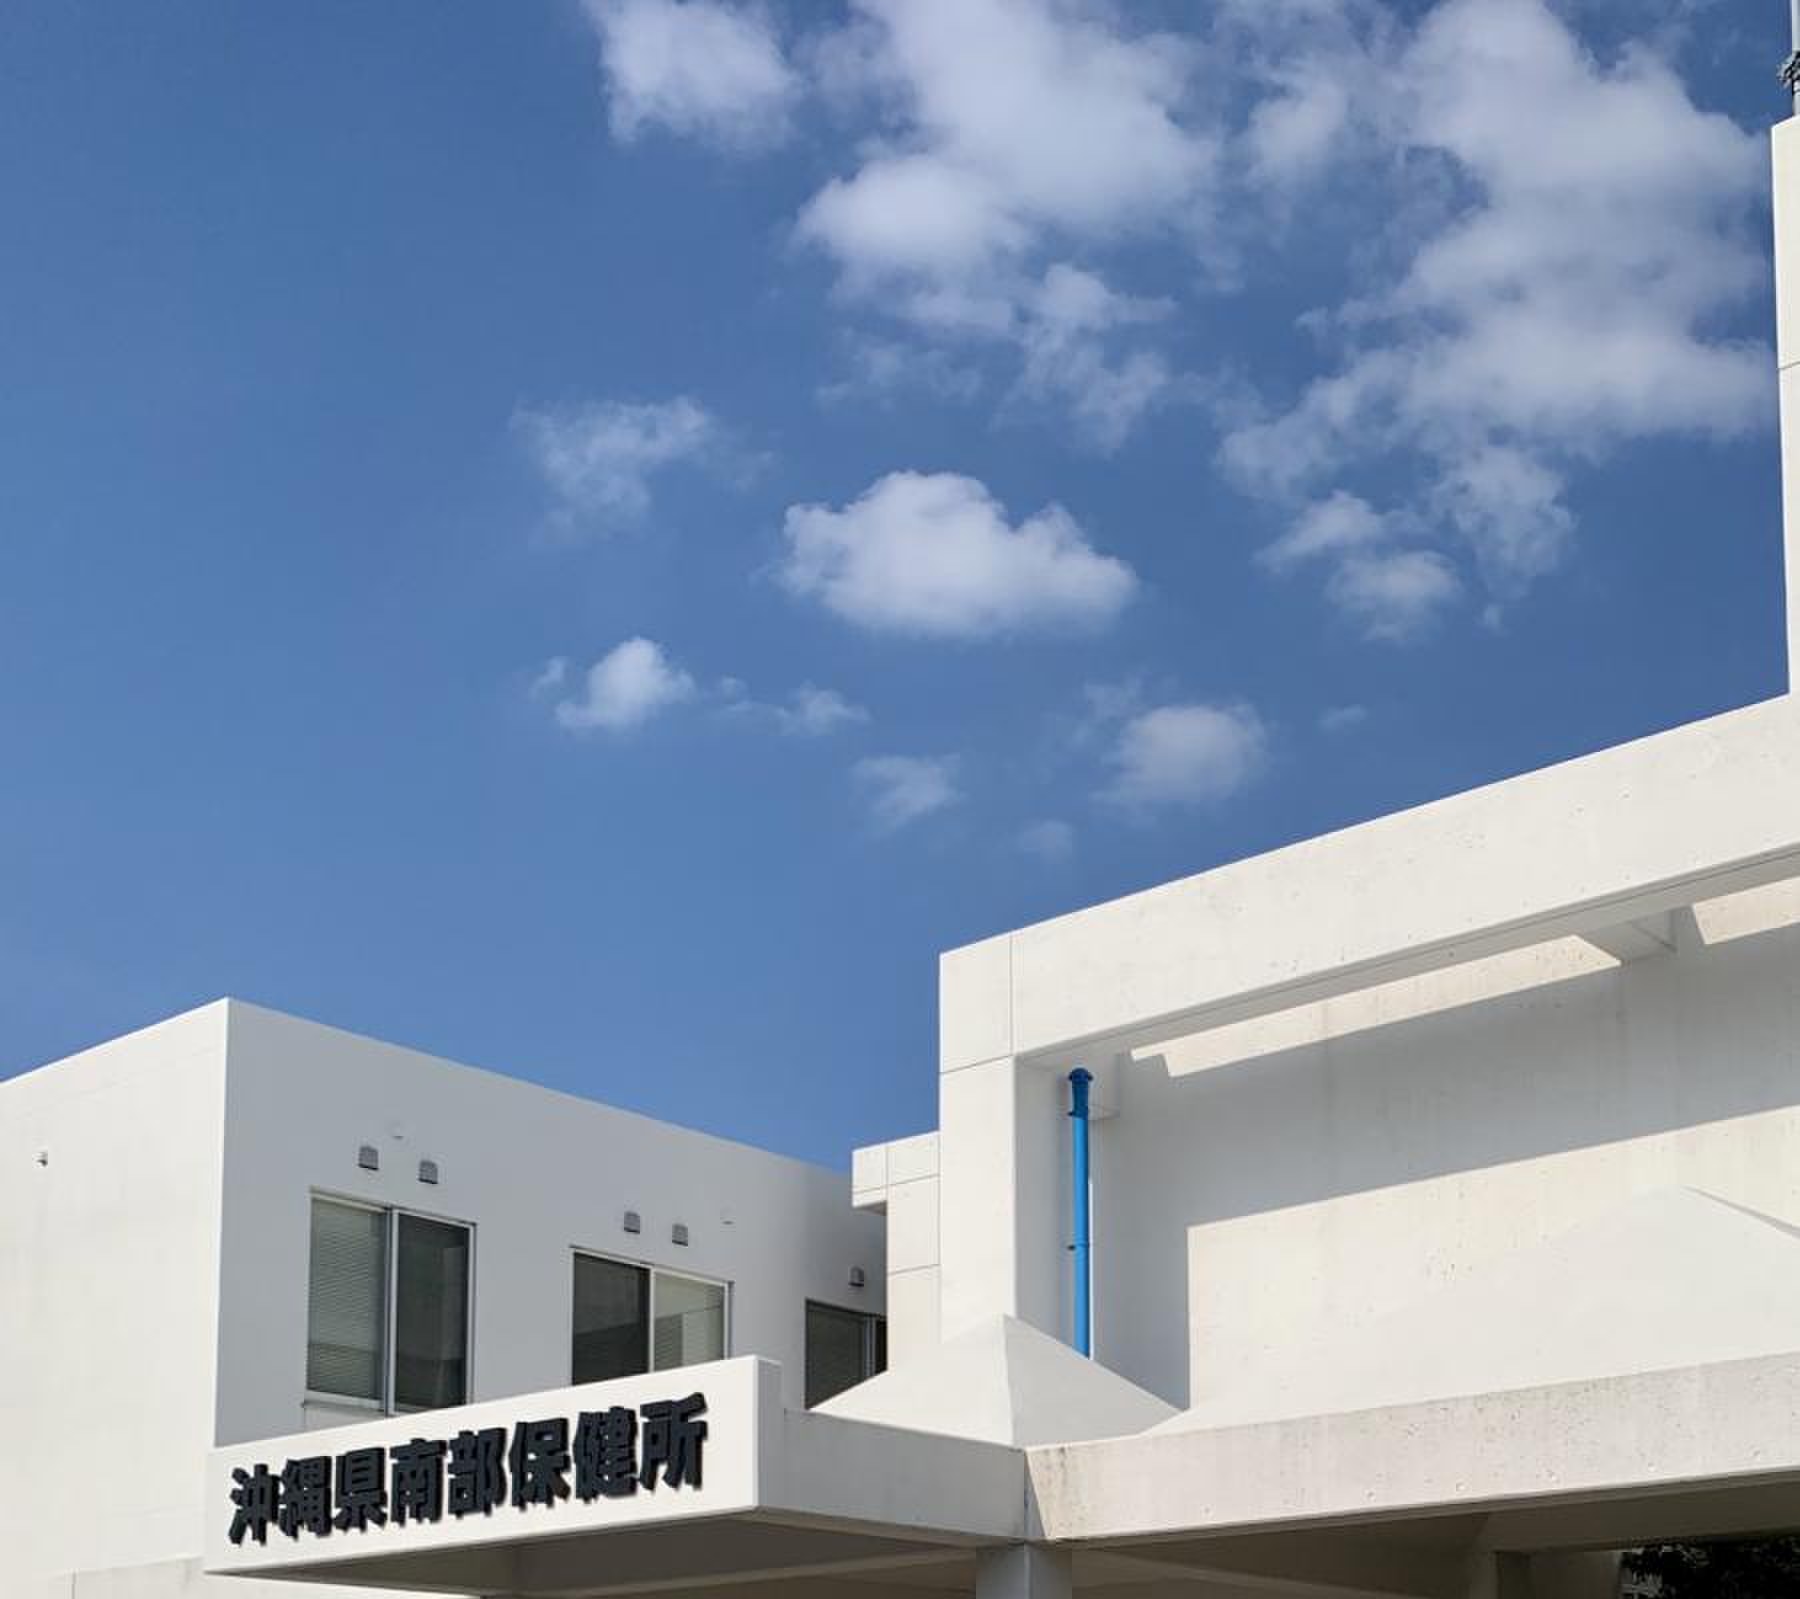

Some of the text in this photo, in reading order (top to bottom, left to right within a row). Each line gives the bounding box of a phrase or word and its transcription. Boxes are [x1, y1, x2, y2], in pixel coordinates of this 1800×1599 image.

[229, 1392, 709, 1544] 沖縄県南部保健所
